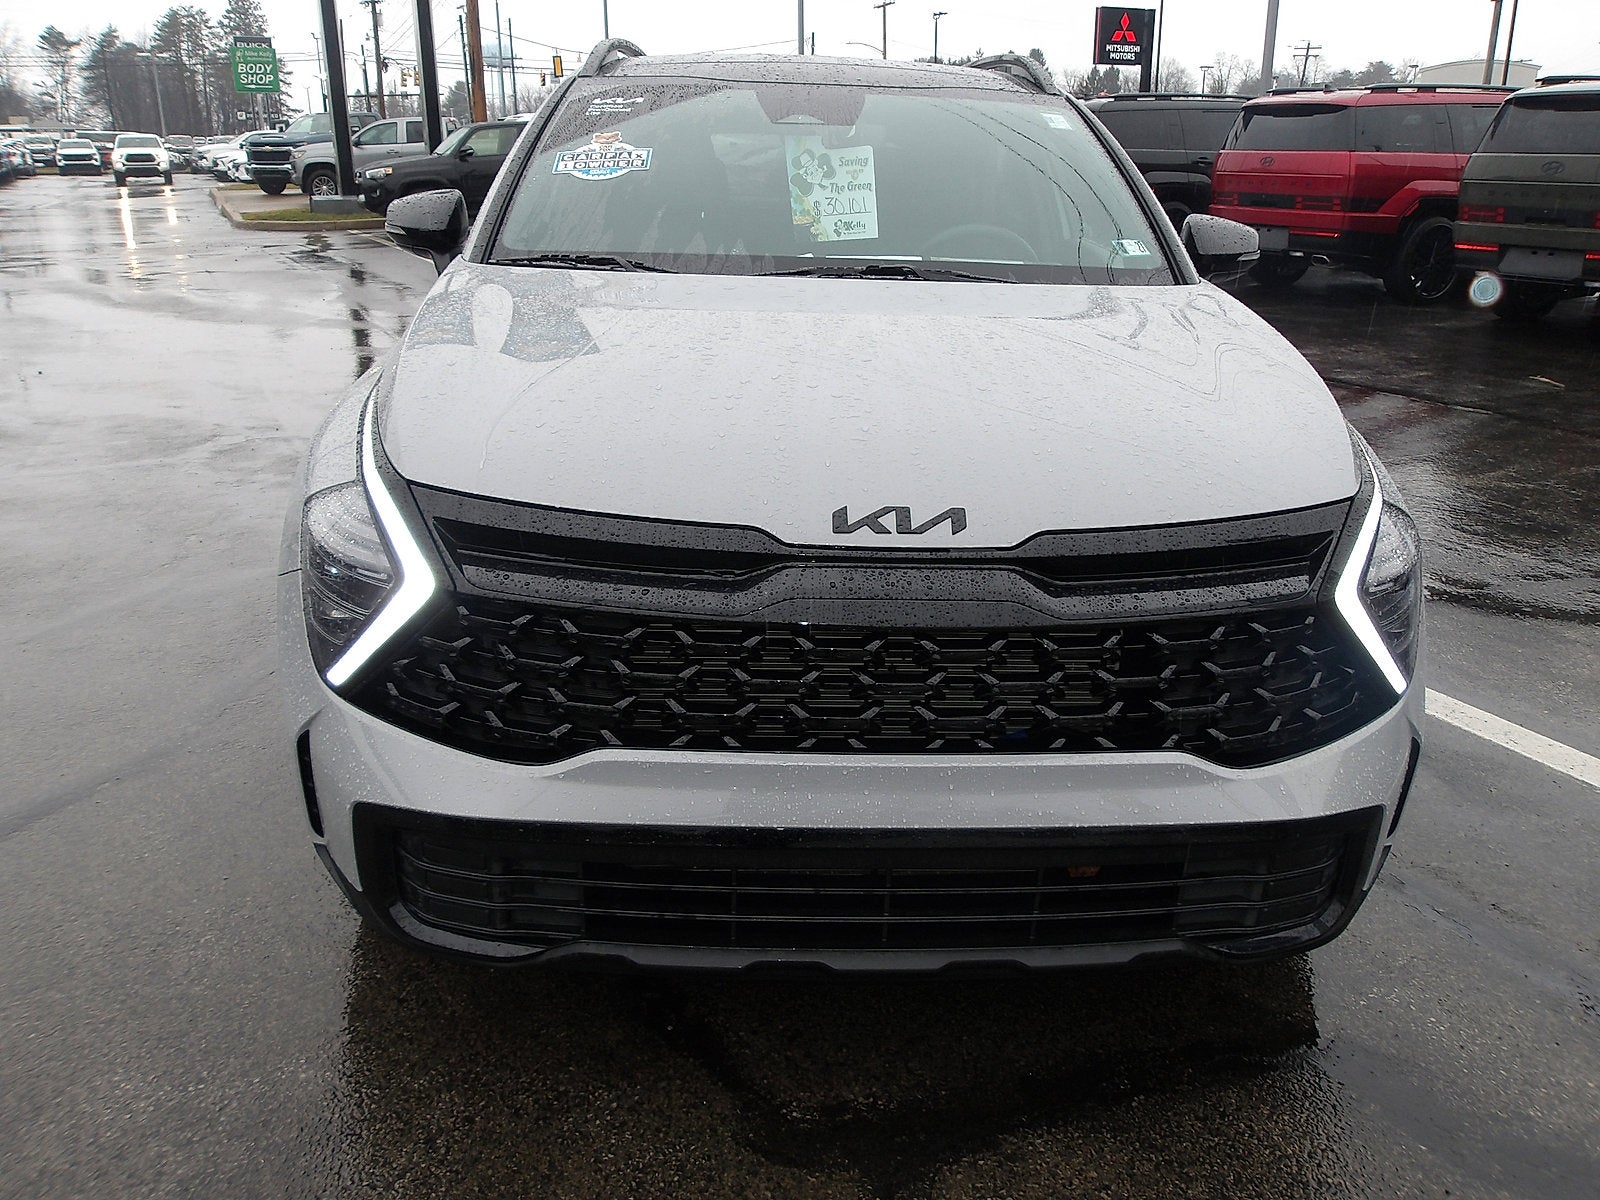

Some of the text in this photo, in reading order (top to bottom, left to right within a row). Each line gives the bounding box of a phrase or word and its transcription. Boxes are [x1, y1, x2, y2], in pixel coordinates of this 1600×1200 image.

[1105, 44, 1141, 53] MITSUBISHI
[1109, 52, 1136, 60] MOTORS
[237, 63, 273, 74] BODY
[239, 73, 274, 84] SHOP
[561, 151, 646, 162] CARFAX
[838, 155, 869, 167] Saving
[573, 159, 646, 169] OWNER
[829, 180, 873, 195] The Green
[832, 505, 967, 536] KIA
